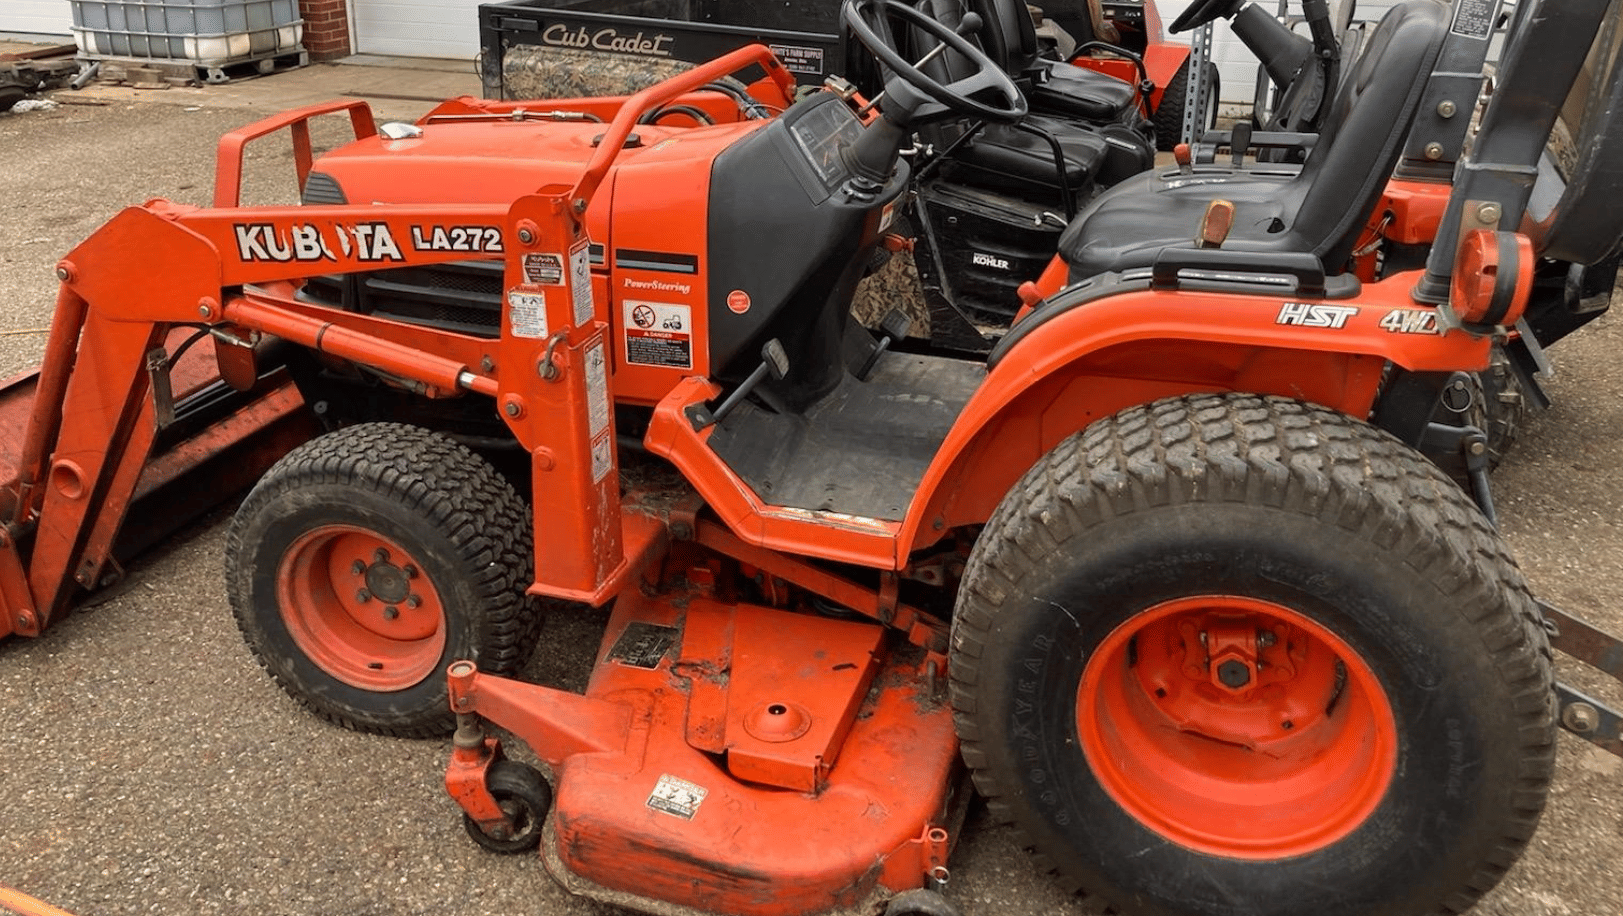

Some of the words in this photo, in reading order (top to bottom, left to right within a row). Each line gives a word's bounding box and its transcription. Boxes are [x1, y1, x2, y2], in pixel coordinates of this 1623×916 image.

[542, 23, 590, 48] Cub
[591, 28, 674, 56] Cadet
[411, 225, 504, 251] LA272
[973, 256, 1009, 269] KOHLER
[624, 278, 691, 294] PowerSteering
[1275, 302, 1361, 329] HST
[1378, 309, 1441, 335] 4WD
